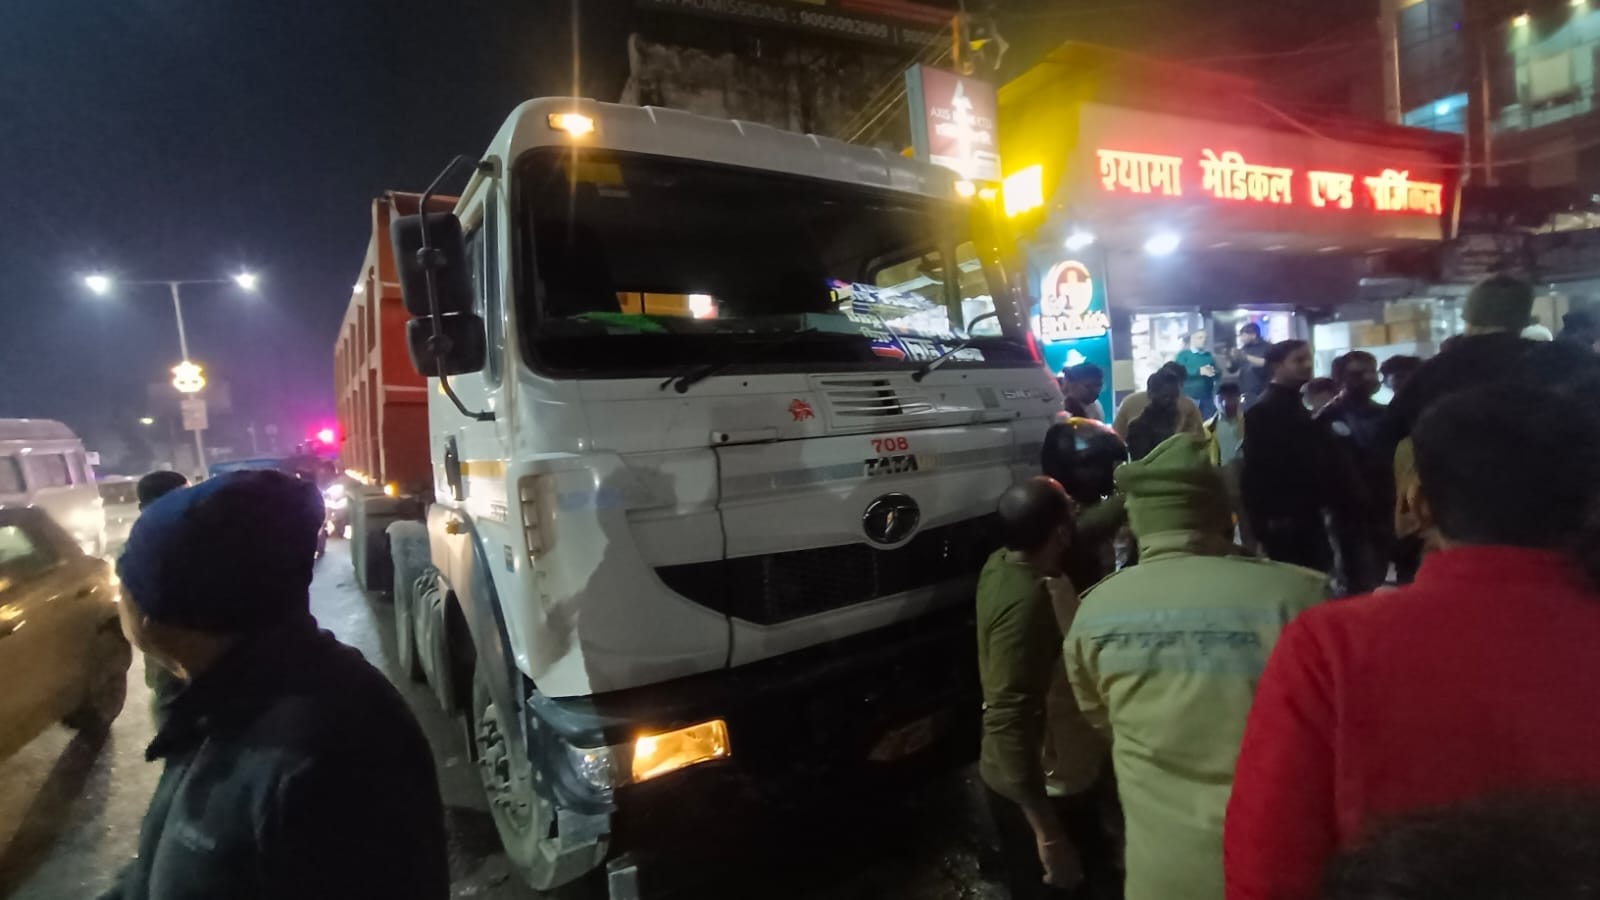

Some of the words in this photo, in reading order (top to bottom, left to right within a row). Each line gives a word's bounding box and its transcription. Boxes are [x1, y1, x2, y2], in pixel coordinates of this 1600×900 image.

[1097, 149, 1183, 196] श्यामा
[1199, 148, 1294, 204] मेडिकल
[870, 437, 909, 453] 708
[864, 454, 919, 477] TATA
